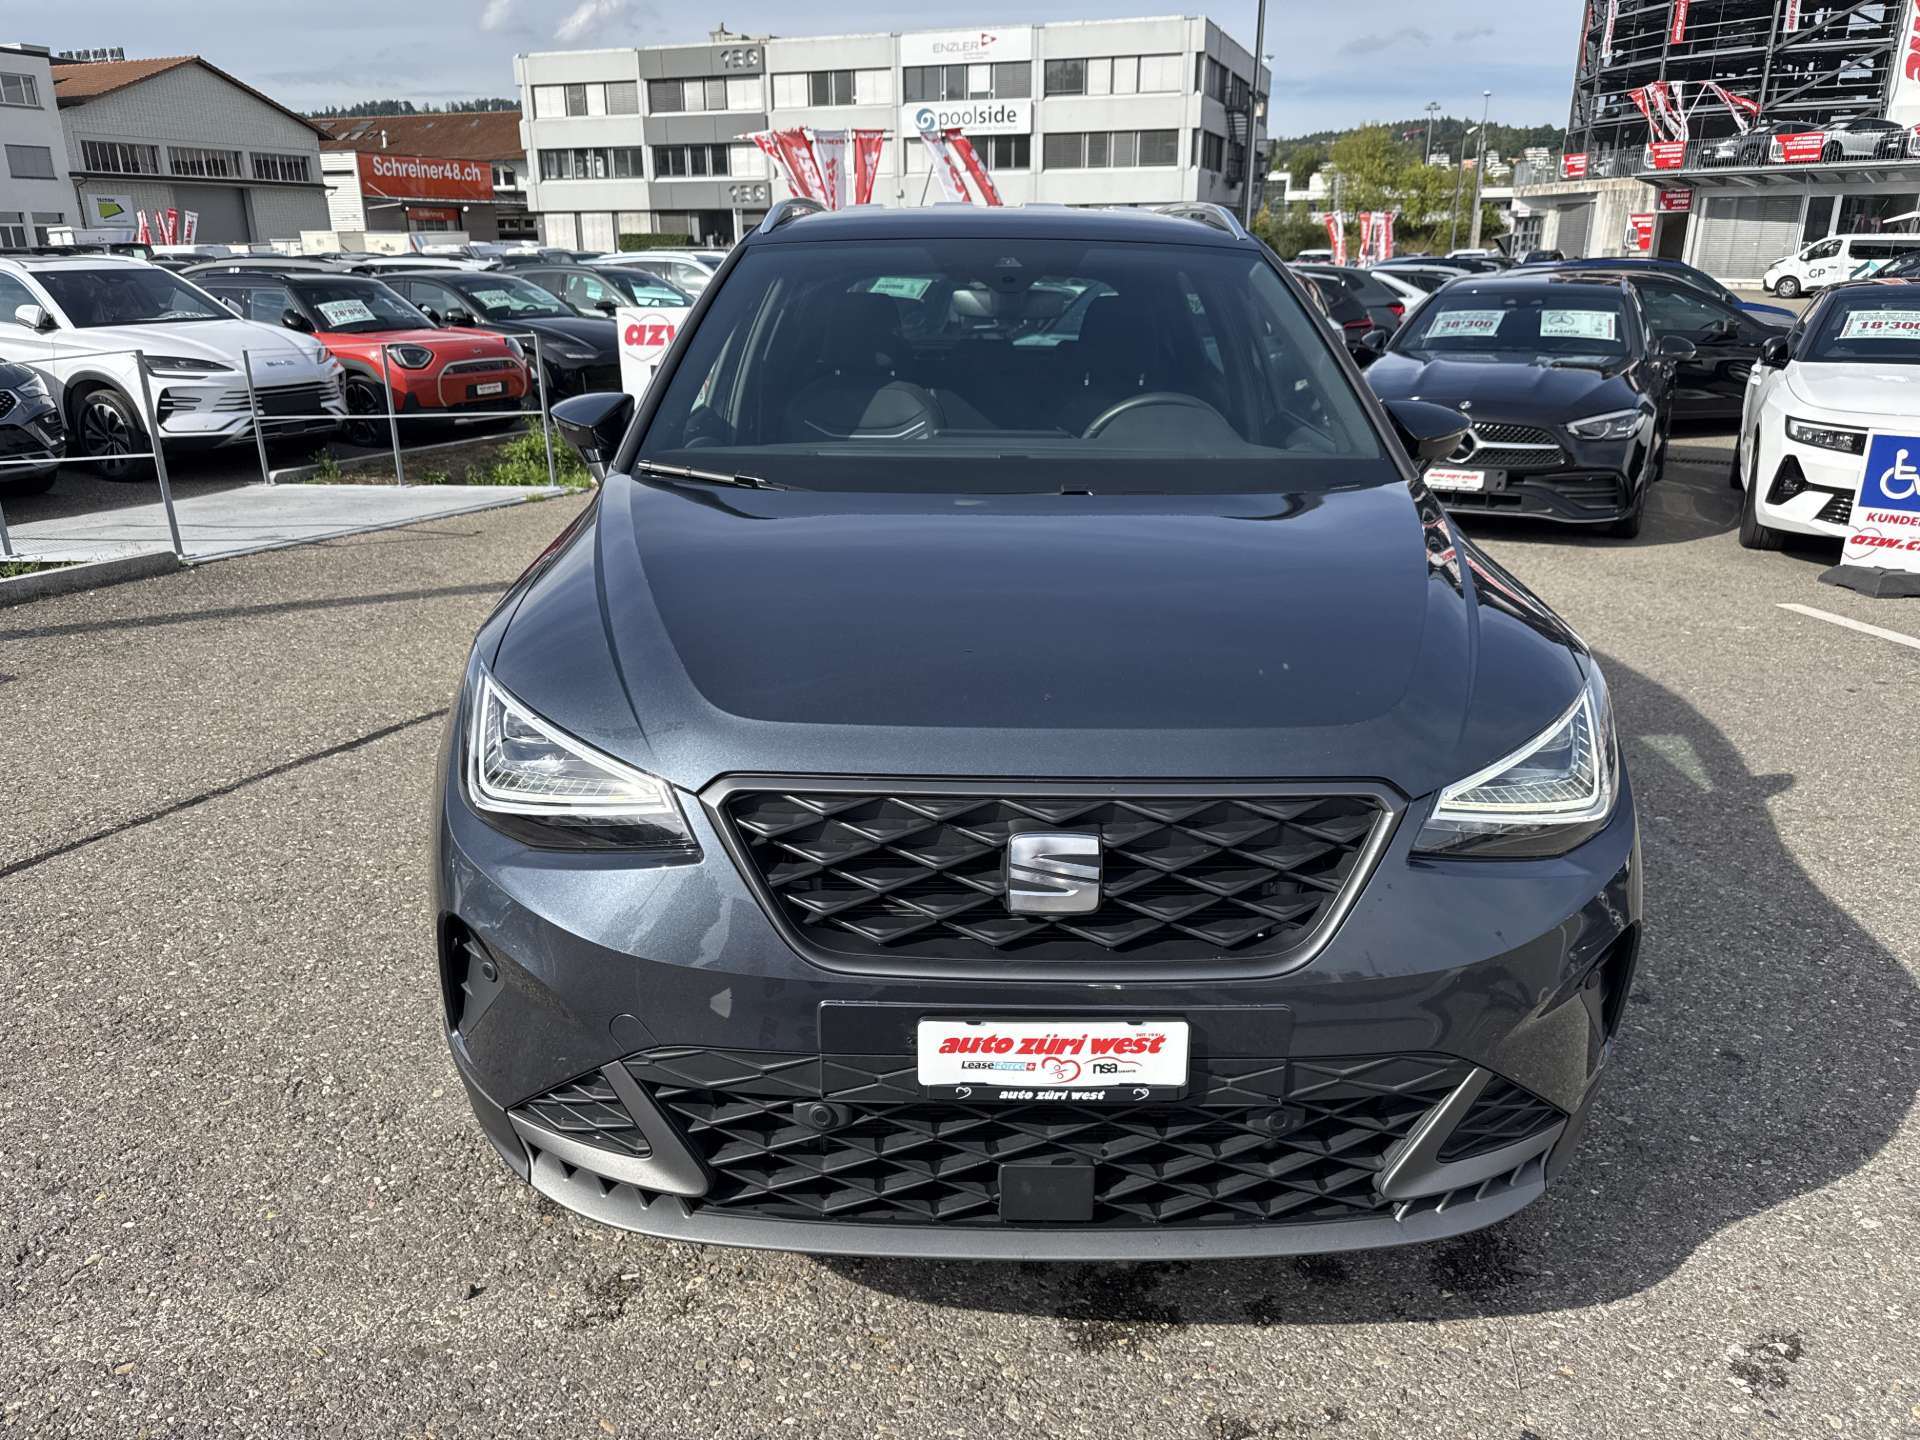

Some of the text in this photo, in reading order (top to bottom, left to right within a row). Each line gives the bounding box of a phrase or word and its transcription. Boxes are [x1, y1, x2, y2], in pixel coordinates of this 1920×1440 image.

[932, 41, 979, 53] ENZLER
[721, 49, 758, 69] 139
[939, 104, 1017, 128] poolside
[373, 155, 481, 182] Schreiner48.ch
[729, 184, 766, 203] 139
[1808, 268, 1826, 278] GP
[1866, 511, 1920, 527] KUNDE
[1850, 534, 1920, 551] azw.c
[939, 1033, 1167, 1055] auto züri west
[1093, 1062, 1117, 1074] nsa
[999, 1089, 1105, 1100] auto züri west
